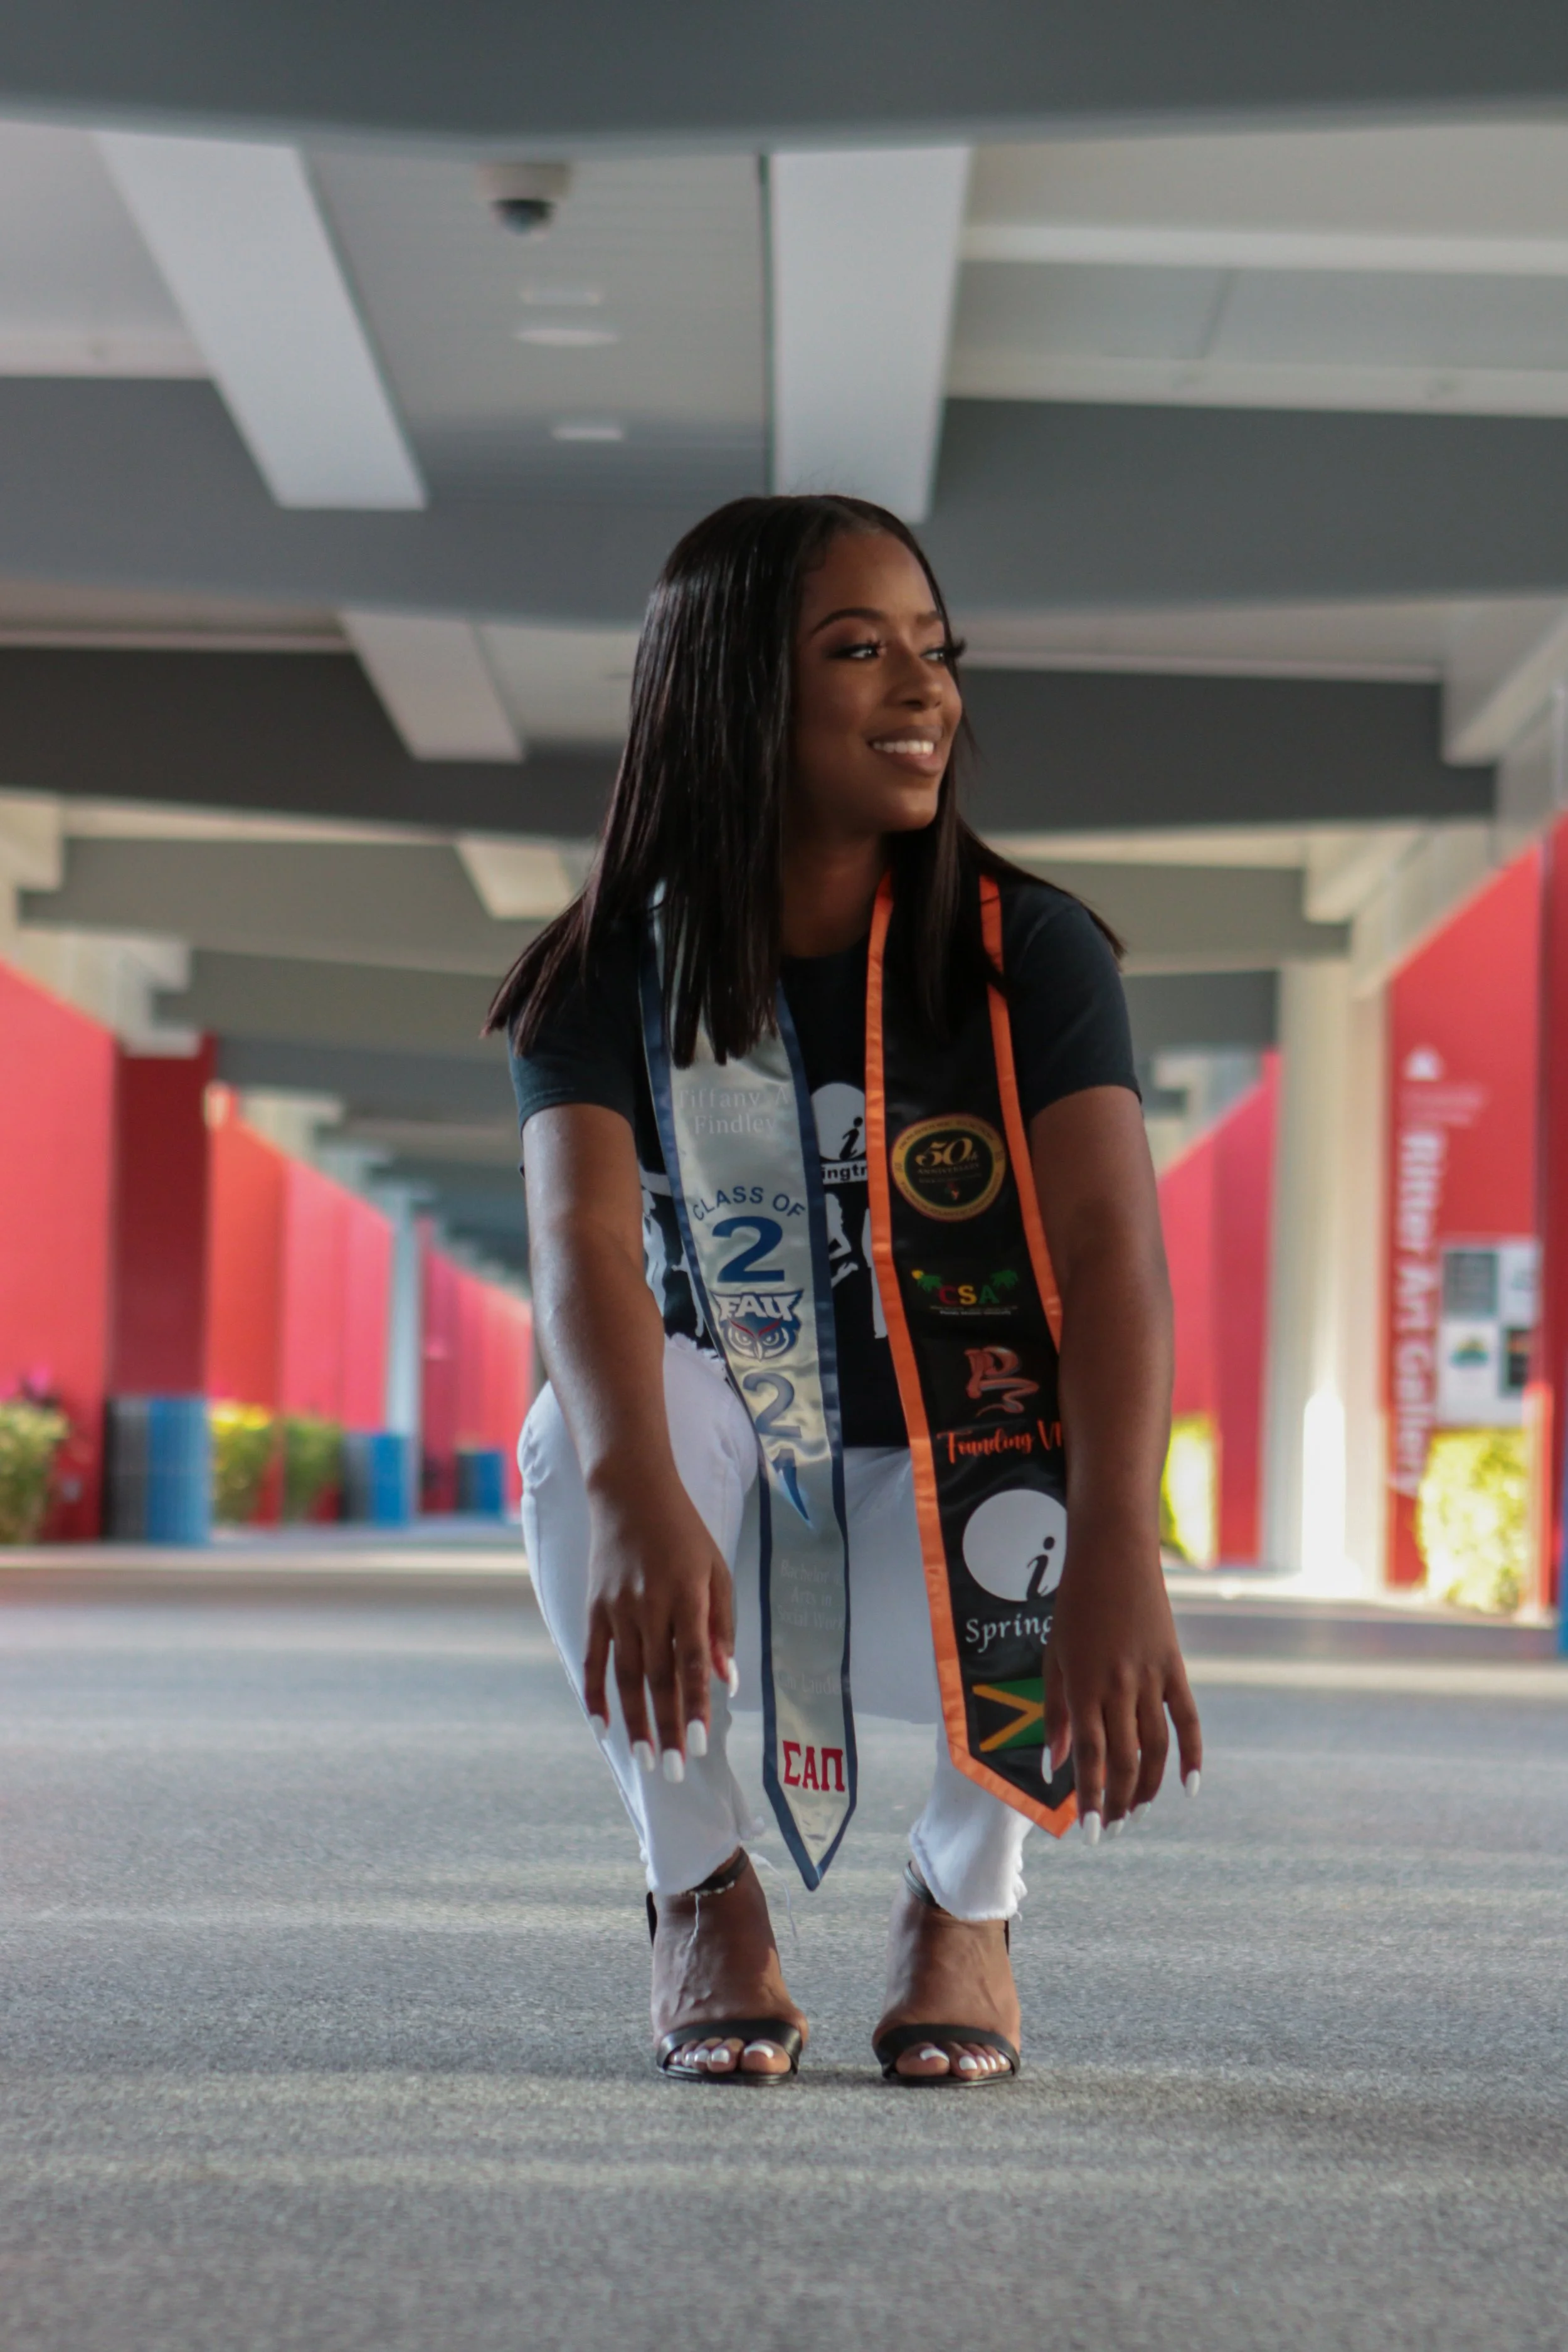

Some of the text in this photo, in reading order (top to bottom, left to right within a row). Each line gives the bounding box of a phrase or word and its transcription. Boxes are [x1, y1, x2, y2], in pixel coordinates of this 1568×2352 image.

[679, 1088, 760, 1109] Tiffany
[694, 1113, 776, 1138] Findley
[692, 1186, 806, 1221] CLASS OF
[1399, 1131, 1444, 1252] Ritter
[712, 1216, 785, 1283] 2
[712, 1293, 799, 1322] FAU
[938, 1284, 1000, 1305] CSA
[1396, 1262, 1438, 1332] Art
[743, 1372, 802, 1439] 2
[936, 1428, 1033, 1464] Founding
[780, 1559, 829, 1584] Bachelor
[778, 1604, 844, 1632] Social Work
